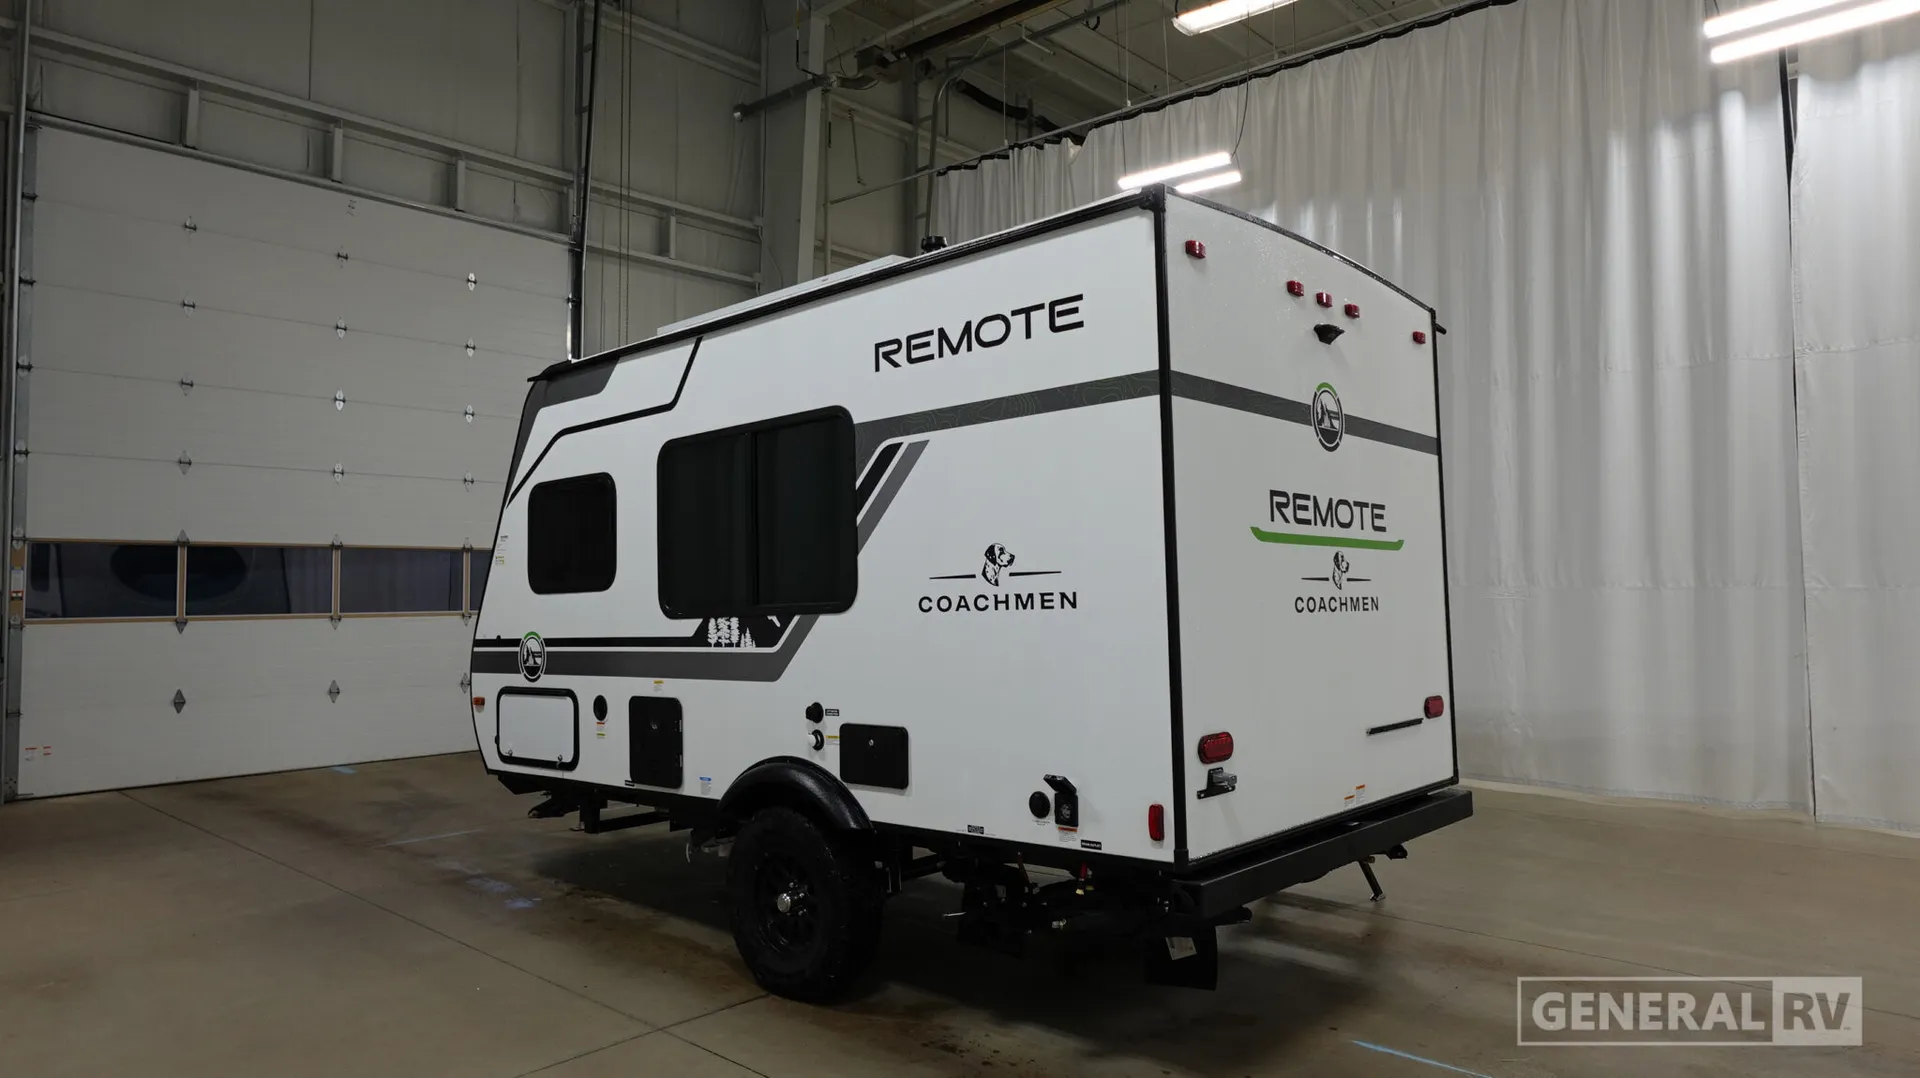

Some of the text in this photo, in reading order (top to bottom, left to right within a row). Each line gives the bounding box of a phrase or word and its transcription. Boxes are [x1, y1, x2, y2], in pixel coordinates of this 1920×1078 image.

[875, 293, 1084, 372] REMOTE
[1269, 489, 1387, 533] REMOTE
[918, 591, 1077, 613] COACHMEN
[1294, 596, 1379, 613] COACHMEN
